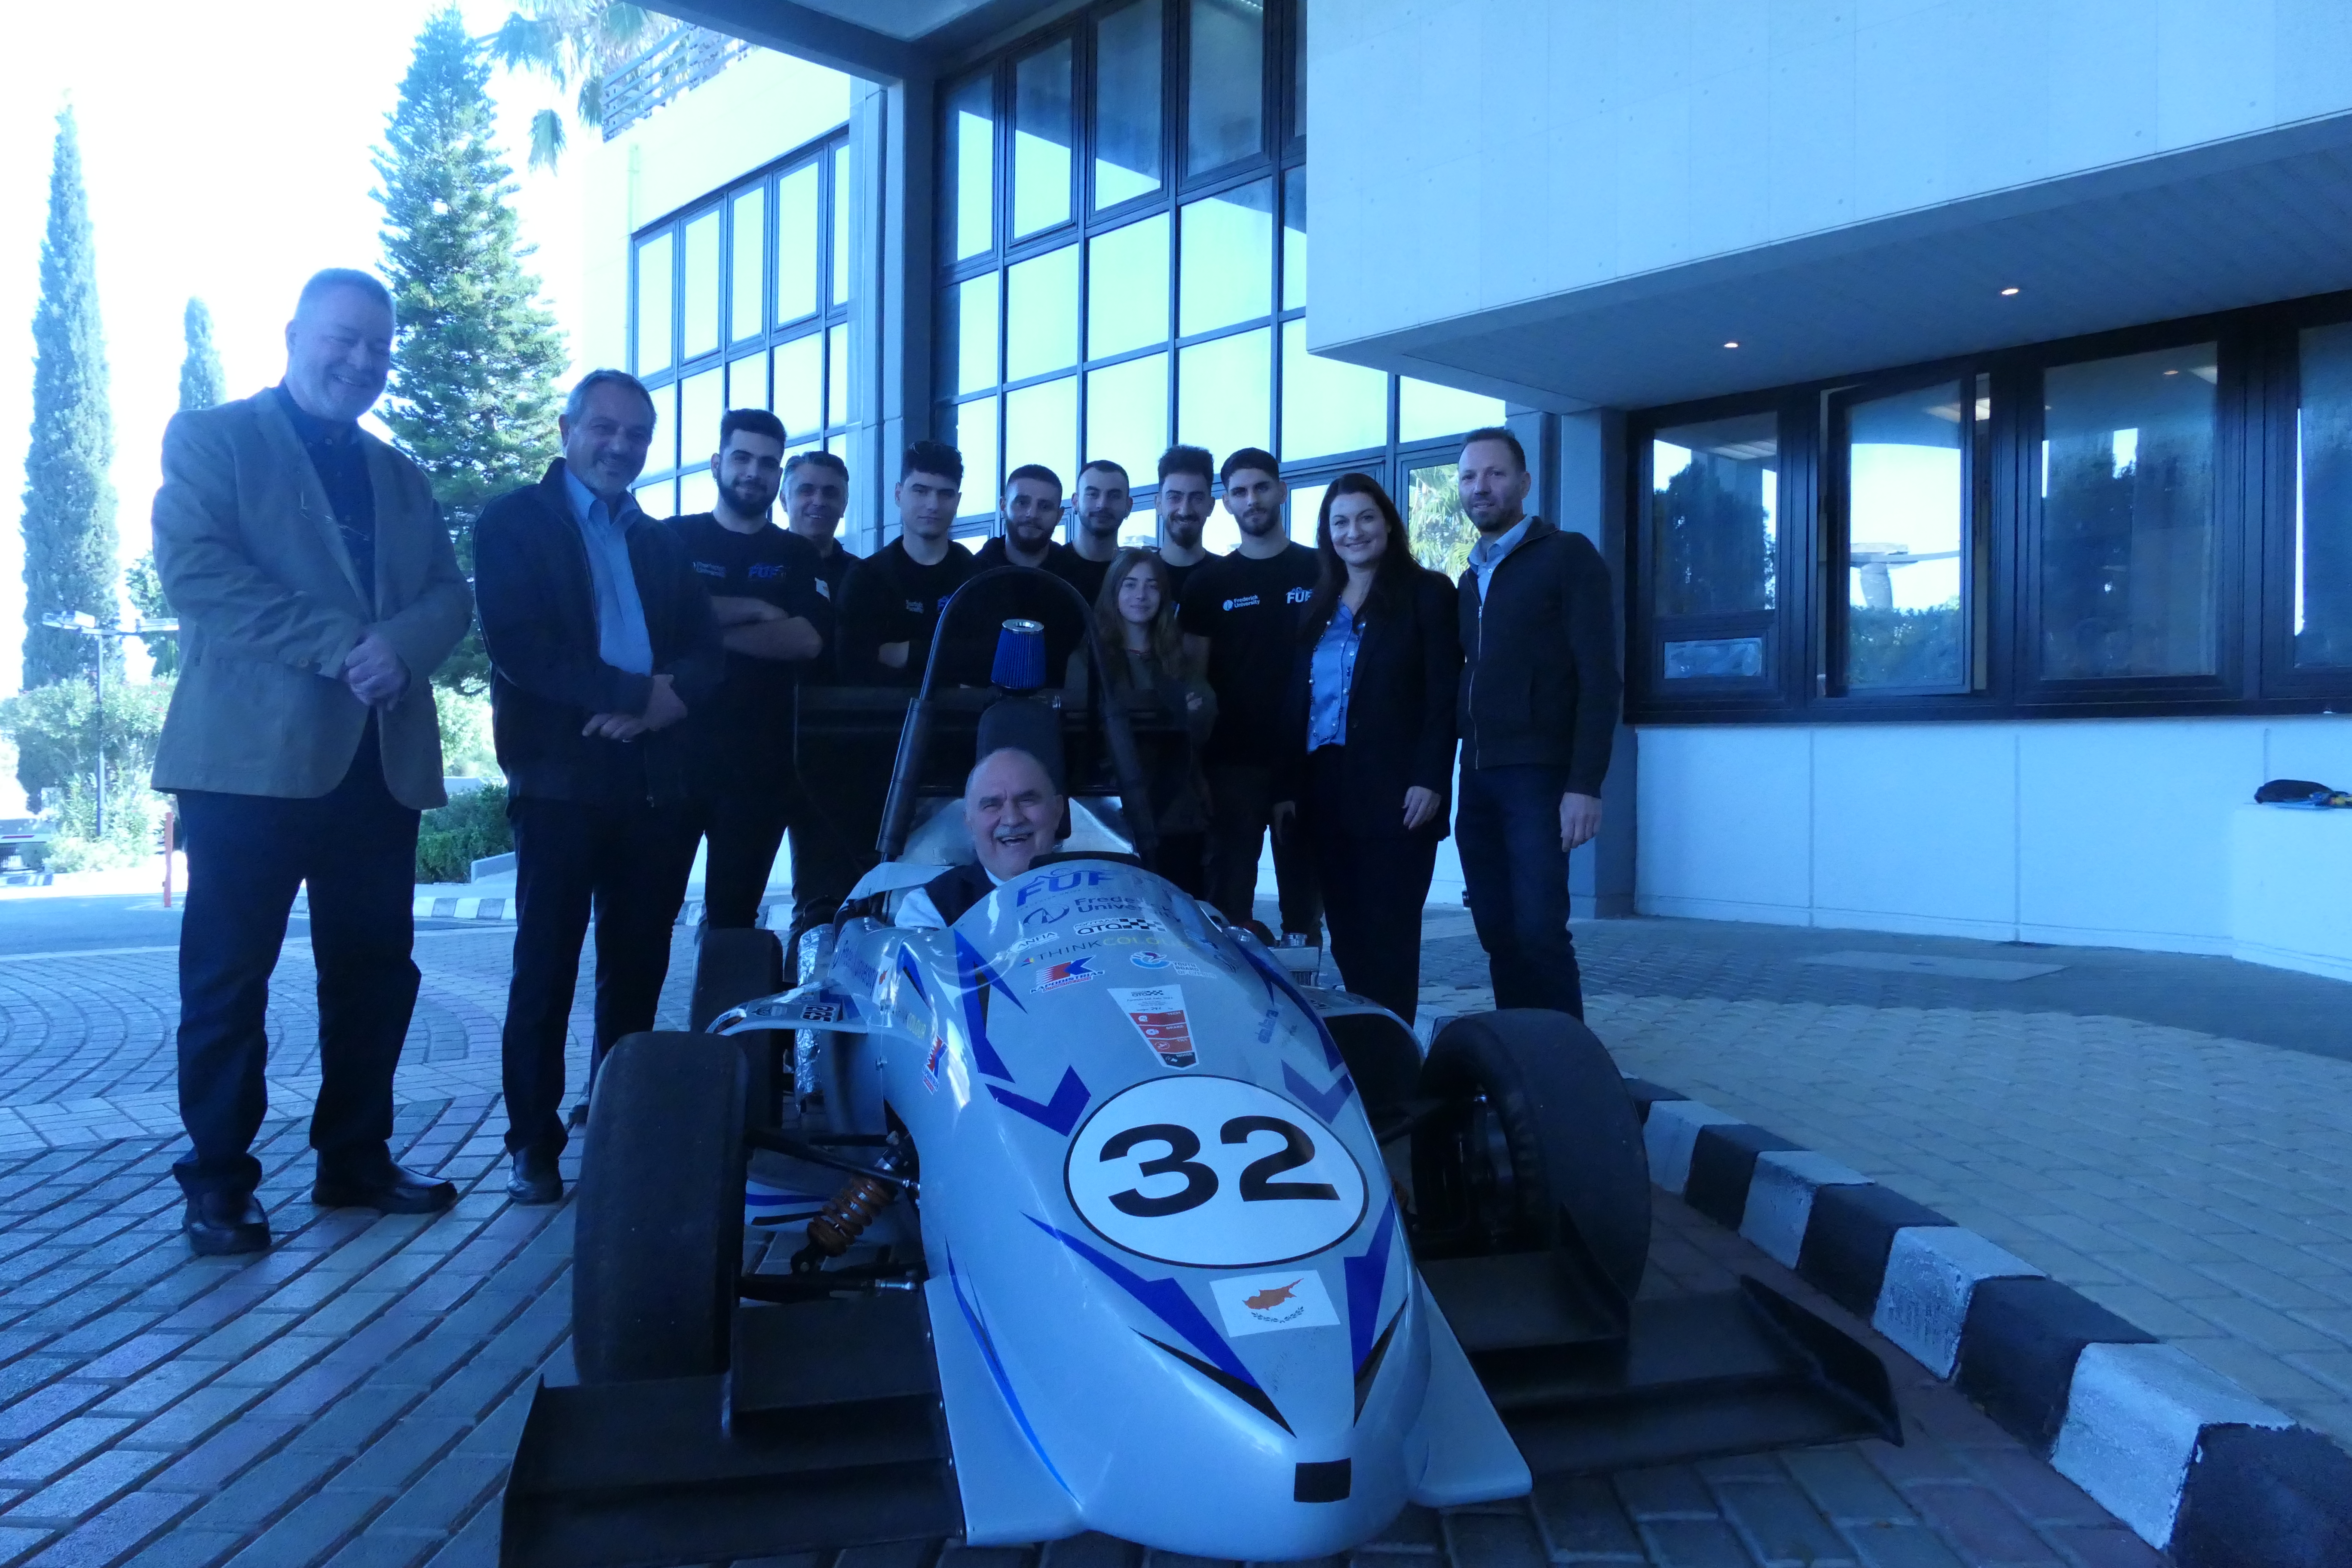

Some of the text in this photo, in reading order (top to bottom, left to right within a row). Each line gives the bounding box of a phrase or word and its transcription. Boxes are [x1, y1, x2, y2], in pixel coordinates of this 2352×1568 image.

[1234, 595, 1258, 603] Frederick
[1234, 600, 1260, 608] University
[1037, 940, 1102, 960] THINK
[1103, 937, 1190, 949] COLO
[1031, 971, 1103, 993] KAPODISTRIAS
[1099, 1115, 1341, 1217] 32
